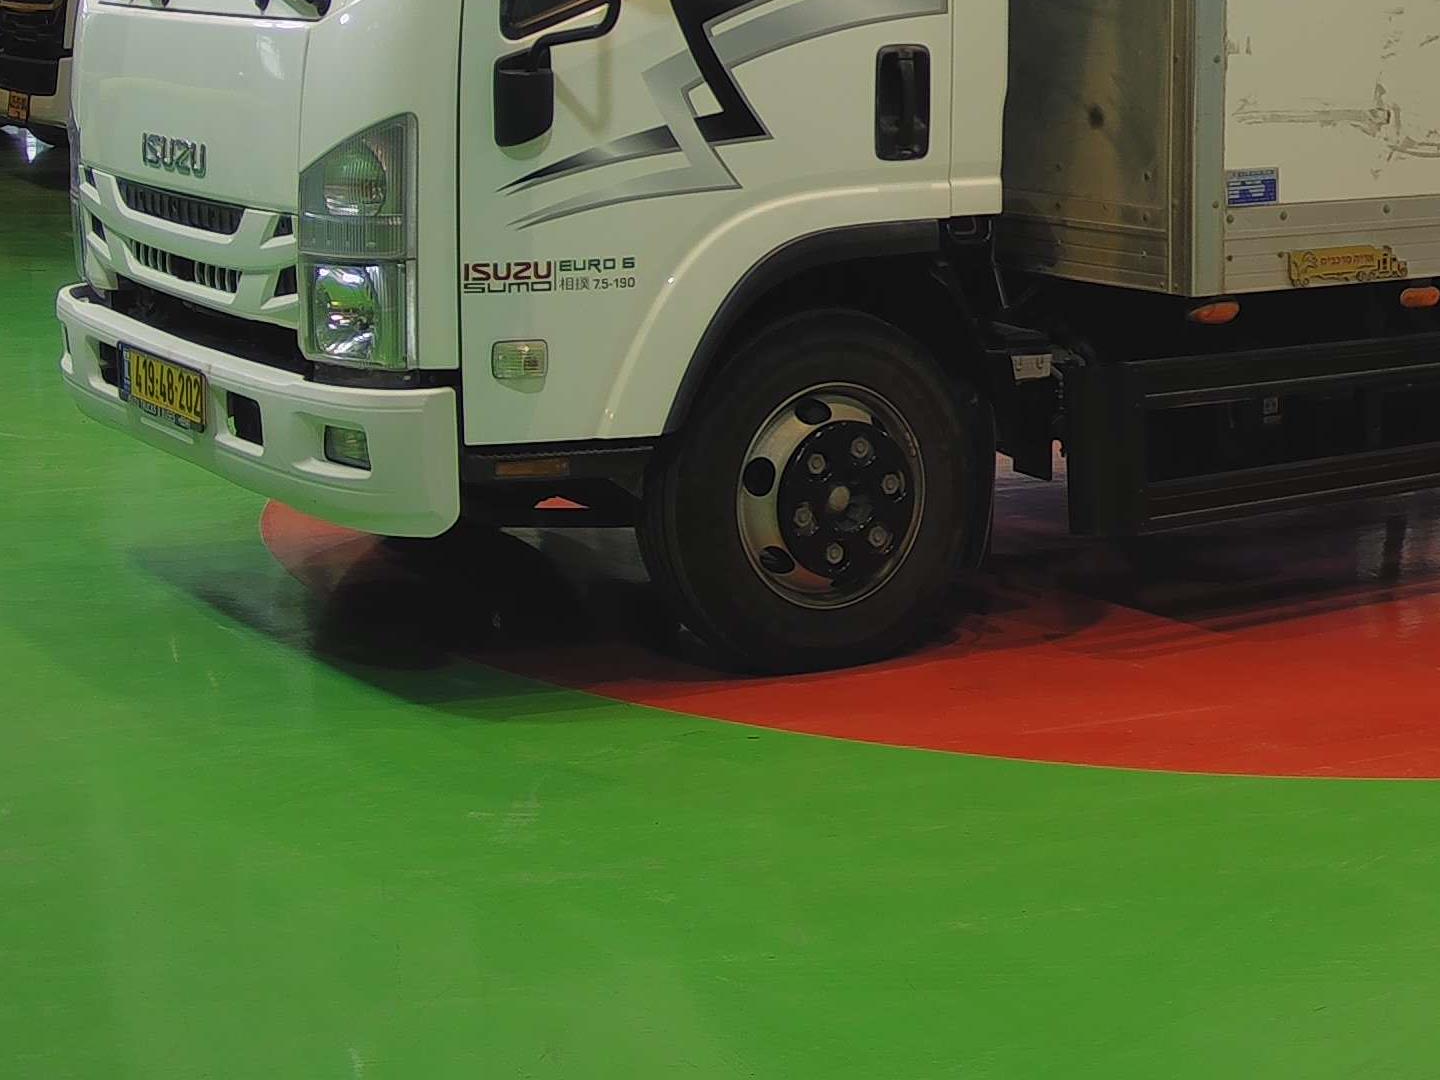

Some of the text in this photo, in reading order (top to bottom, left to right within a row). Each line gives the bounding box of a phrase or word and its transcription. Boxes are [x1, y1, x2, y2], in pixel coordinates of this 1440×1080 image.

[142, 132, 207, 179] ISUZU
[463, 261, 552, 281] ISUZU
[558, 257, 636, 273] EURO 6
[463, 280, 552, 294] SUMO
